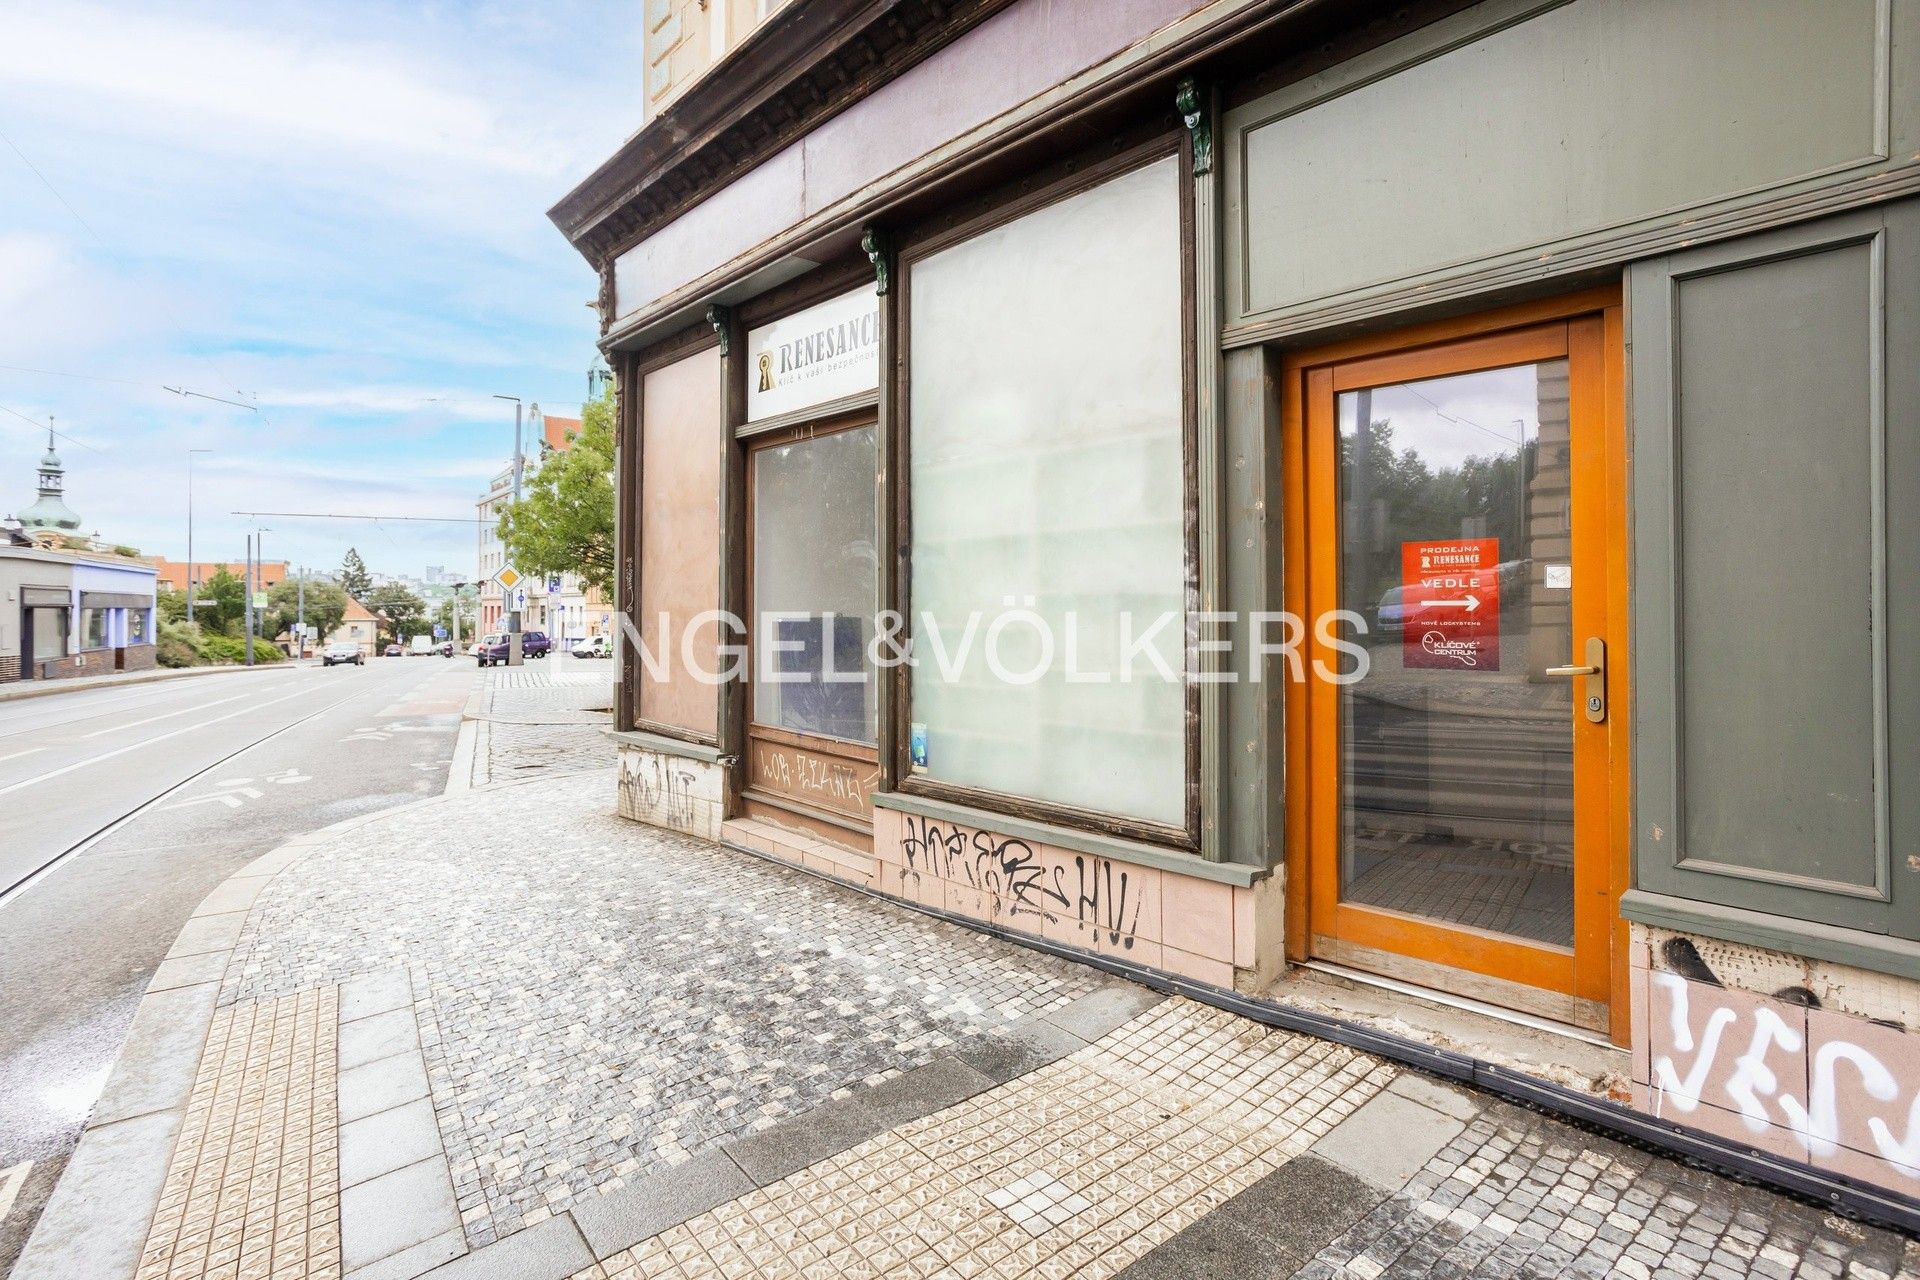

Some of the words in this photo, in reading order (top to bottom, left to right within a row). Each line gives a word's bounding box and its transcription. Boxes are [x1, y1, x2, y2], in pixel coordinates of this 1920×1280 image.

[1420, 546, 1480, 554] PRODEJNA
[1433, 554, 1480, 565] RENESANCE
[1421, 578, 1480, 588] VEDLE
[1433, 641, 1476, 649] KLÍČOVÉ
